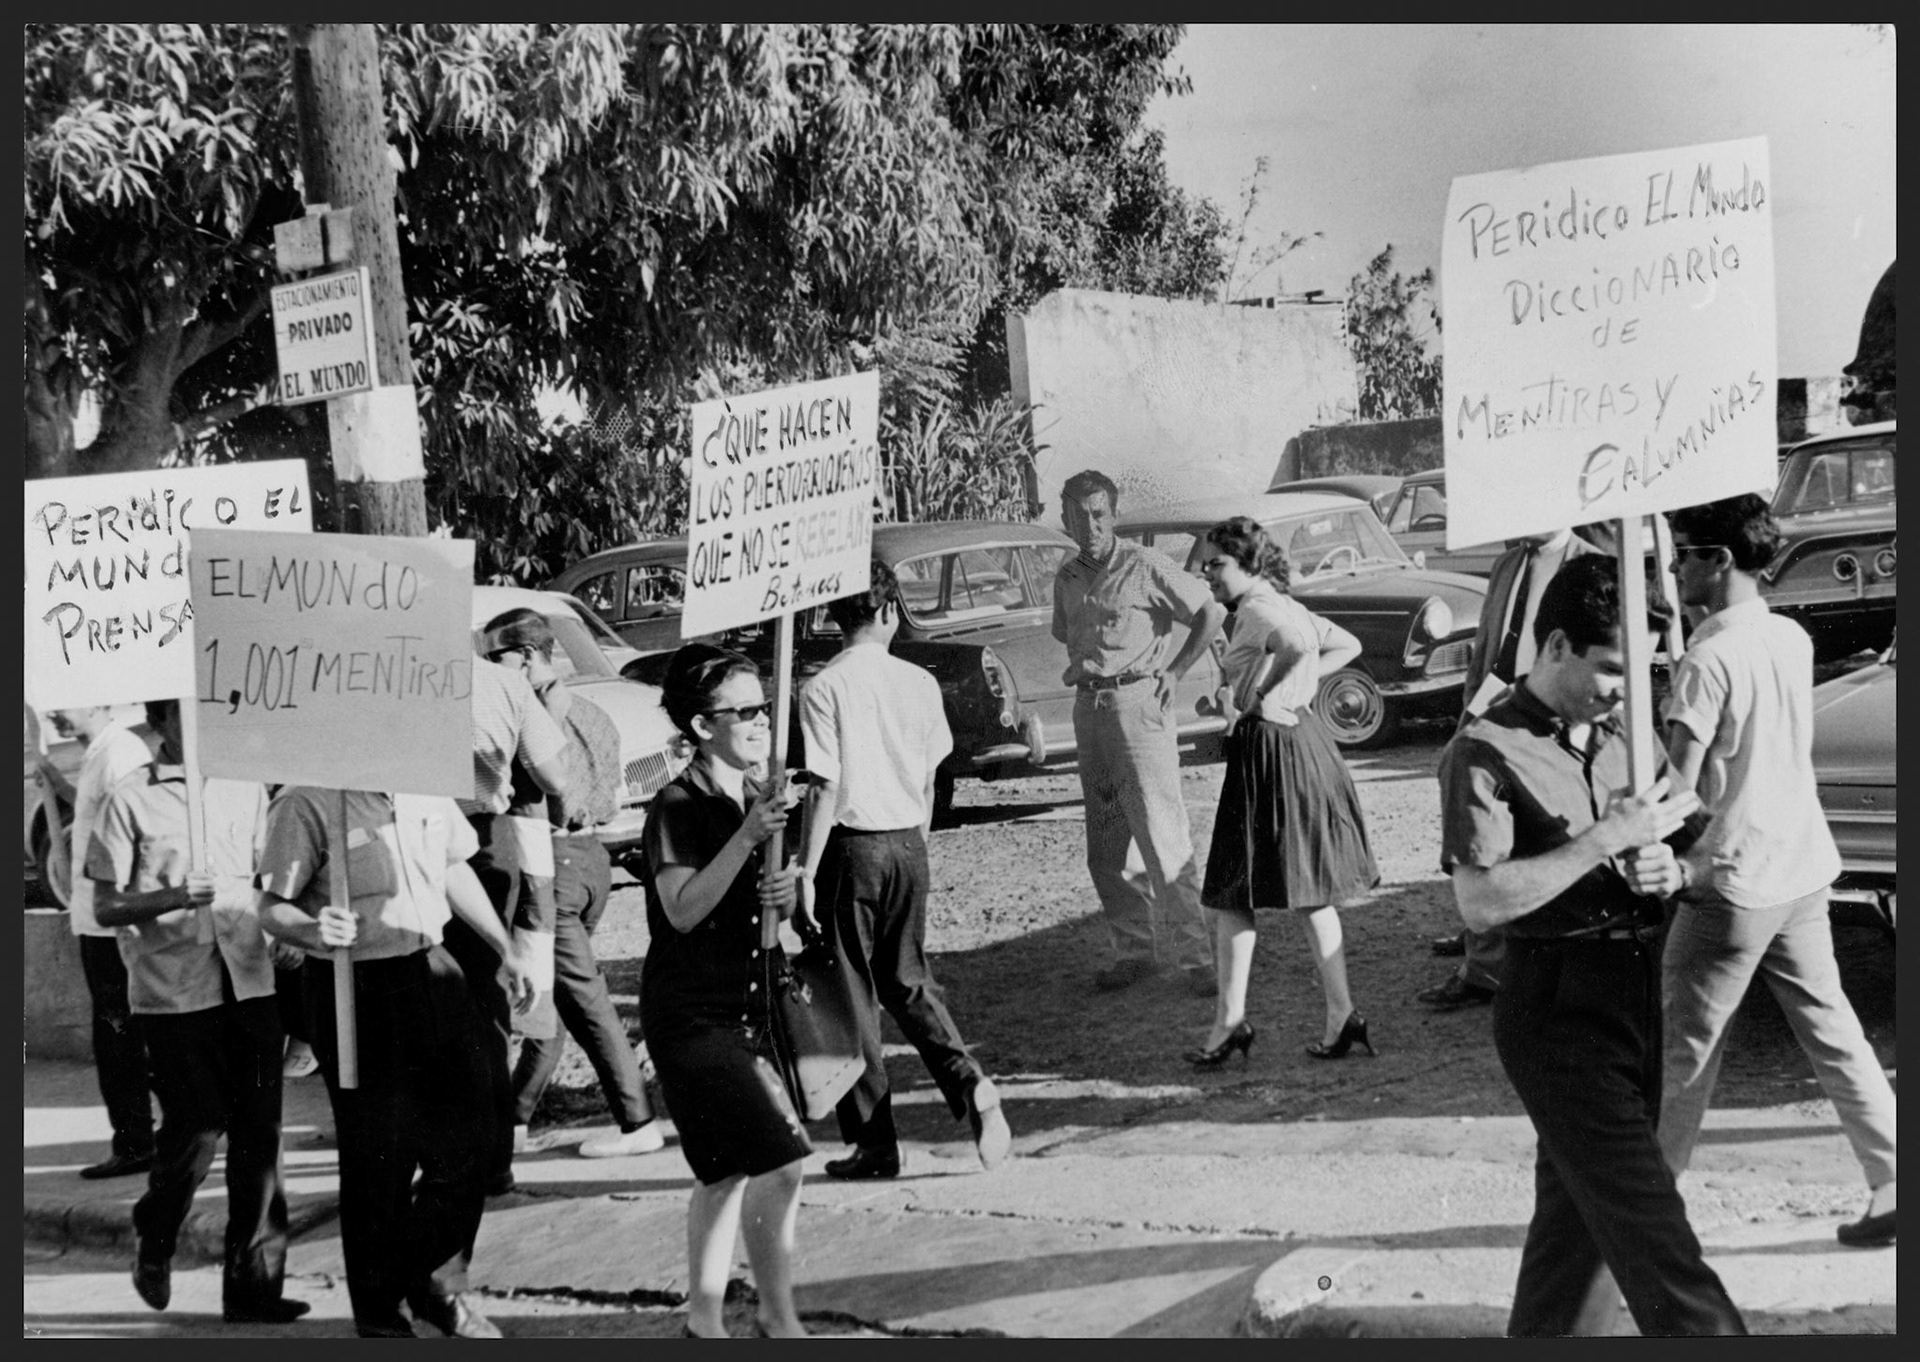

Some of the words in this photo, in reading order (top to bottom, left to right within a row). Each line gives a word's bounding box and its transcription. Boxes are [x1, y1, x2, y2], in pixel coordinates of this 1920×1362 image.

[275, 275, 358, 311] ESTACIONAMIENTO
[288, 312, 353, 343] PRIVADO
[283, 371, 305, 399] EL
[310, 360, 366, 394] MUNDO
[1655, 373, 1679, 433] Y
[779, 397, 852, 450] HACEN
[263, 484, 304, 520] EL
[696, 477, 734, 525] LOS
[207, 558, 257, 598] EL
[692, 532, 733, 591] QUE
[739, 526, 764, 580] NO
[767, 520, 791, 569] SE
[42, 599, 195, 665] PRENSA
[199, 638, 299, 715] 1,001
